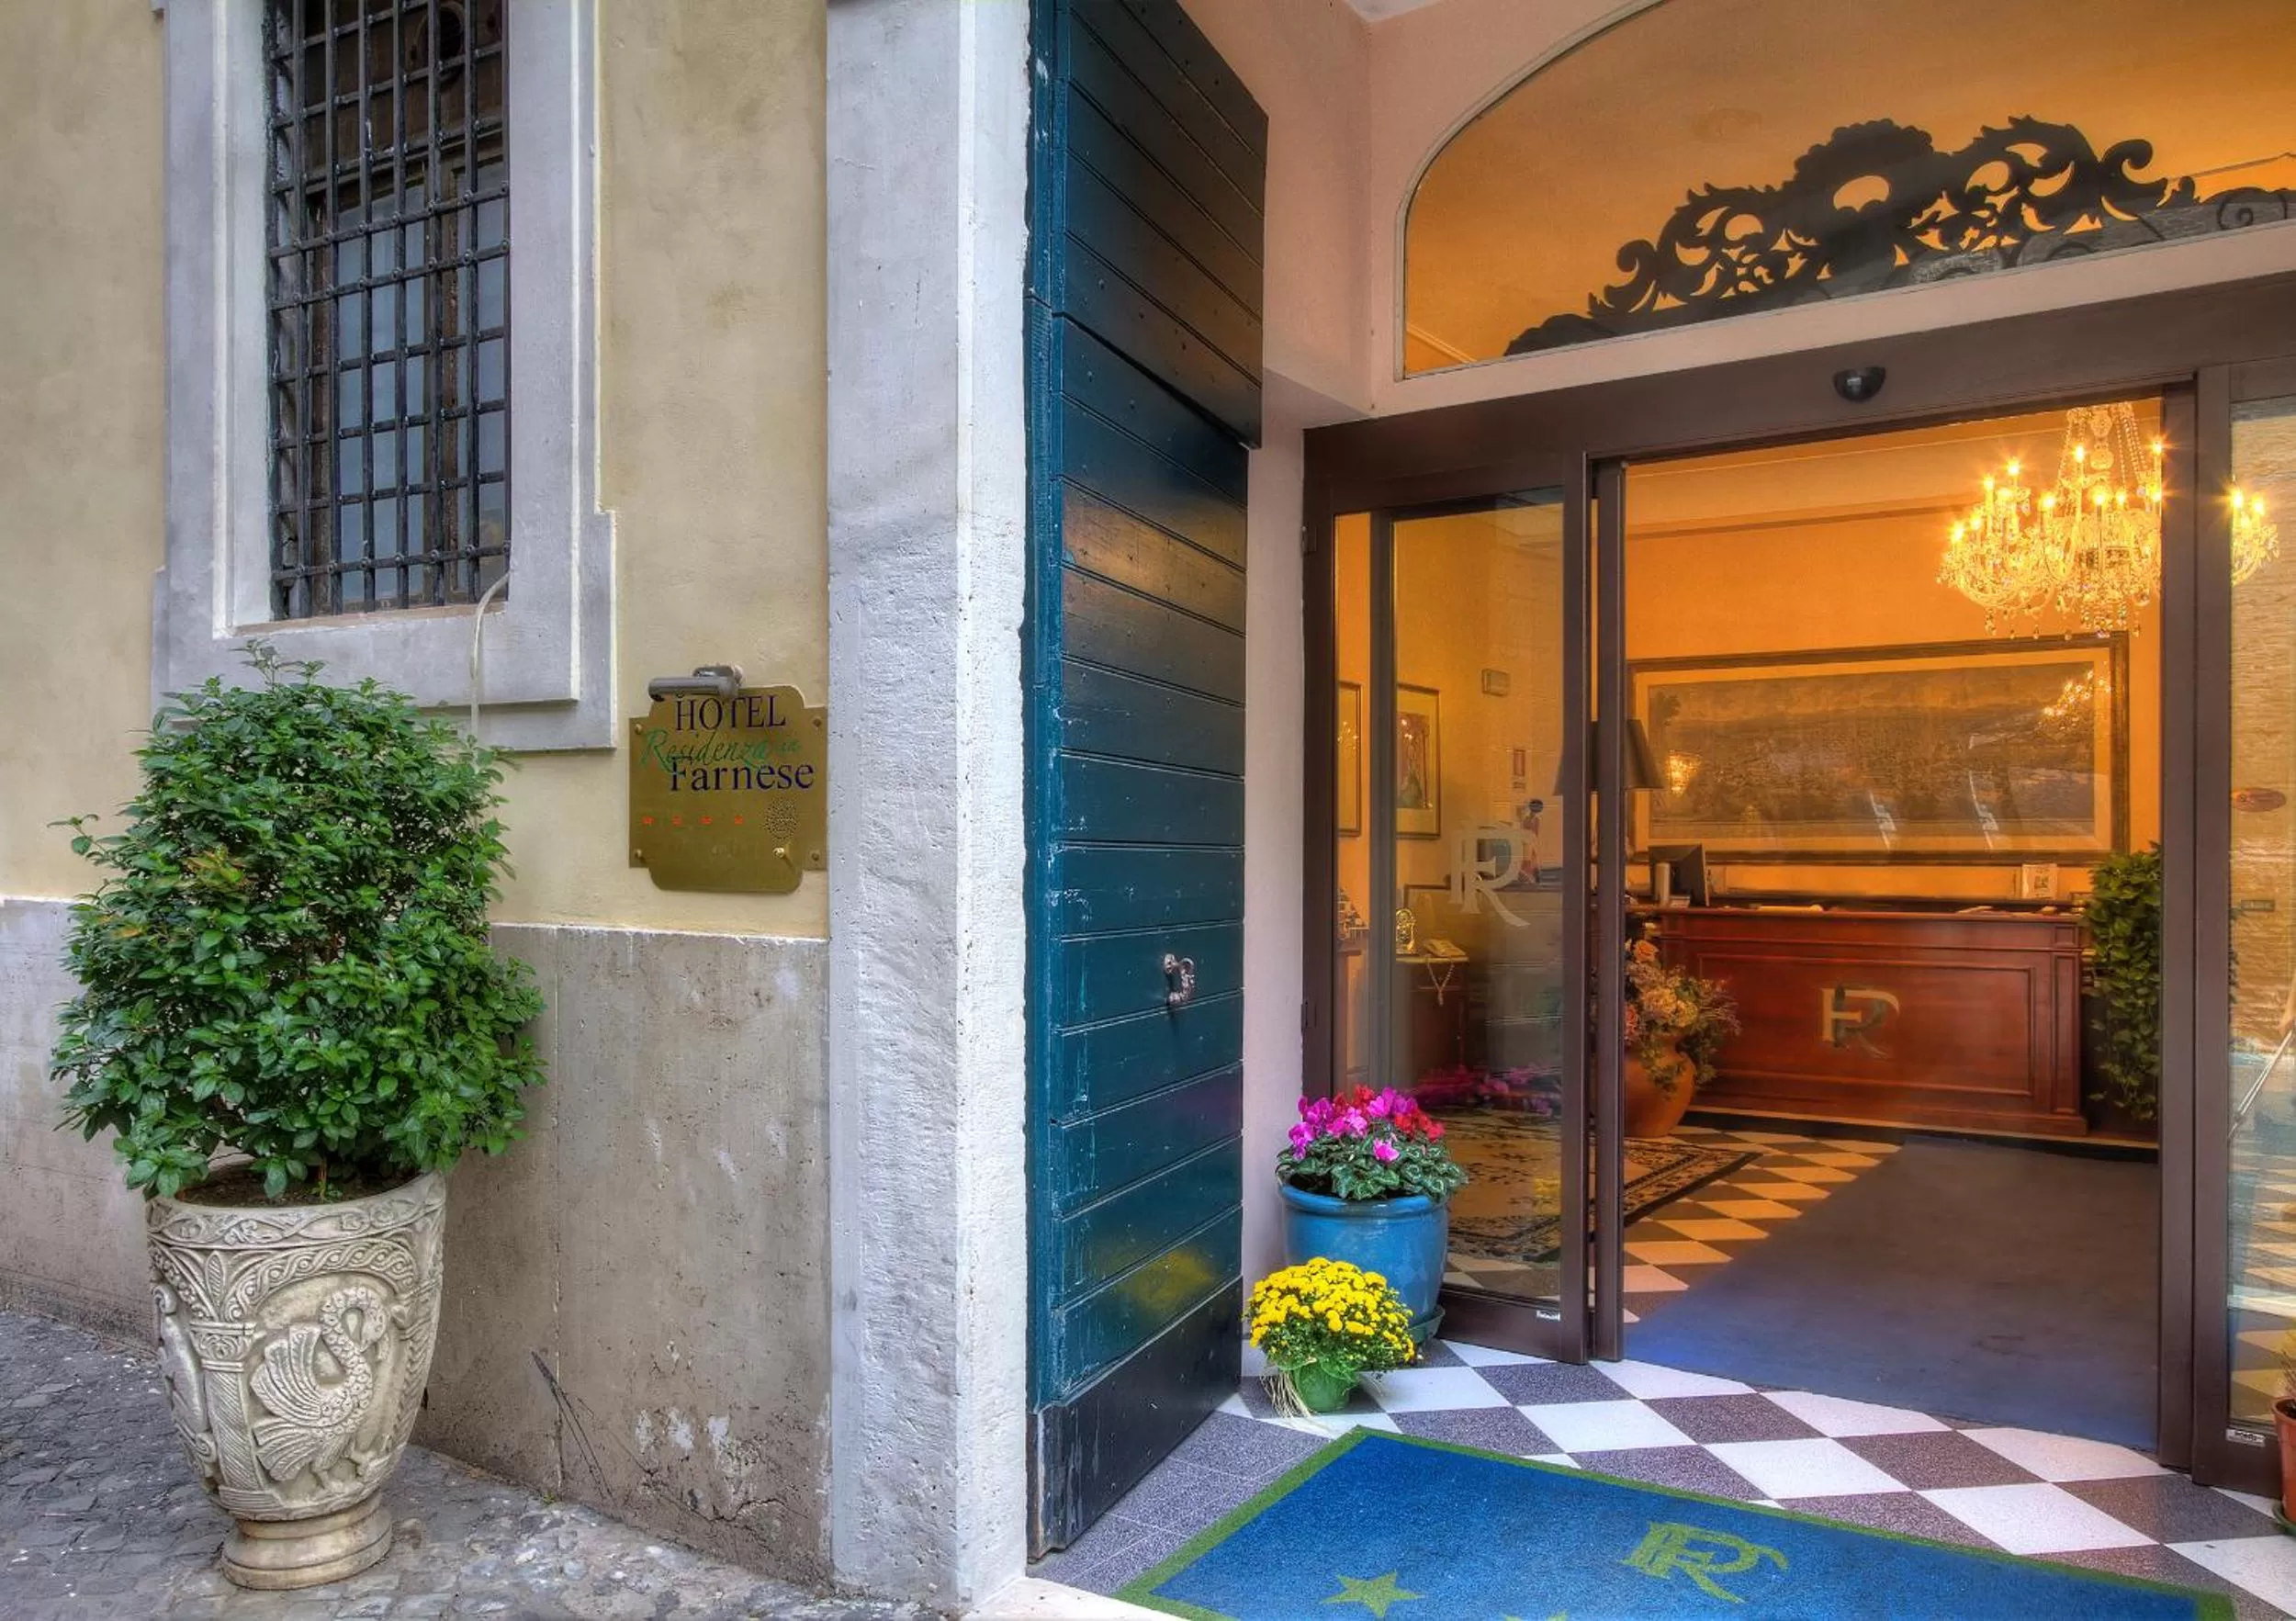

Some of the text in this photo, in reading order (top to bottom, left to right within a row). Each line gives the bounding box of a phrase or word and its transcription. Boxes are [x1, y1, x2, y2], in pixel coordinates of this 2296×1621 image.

[675, 694, 786, 731] HOTEL
[640, 727, 769, 773] Residenza
[670, 755, 815, 792] Farnese
